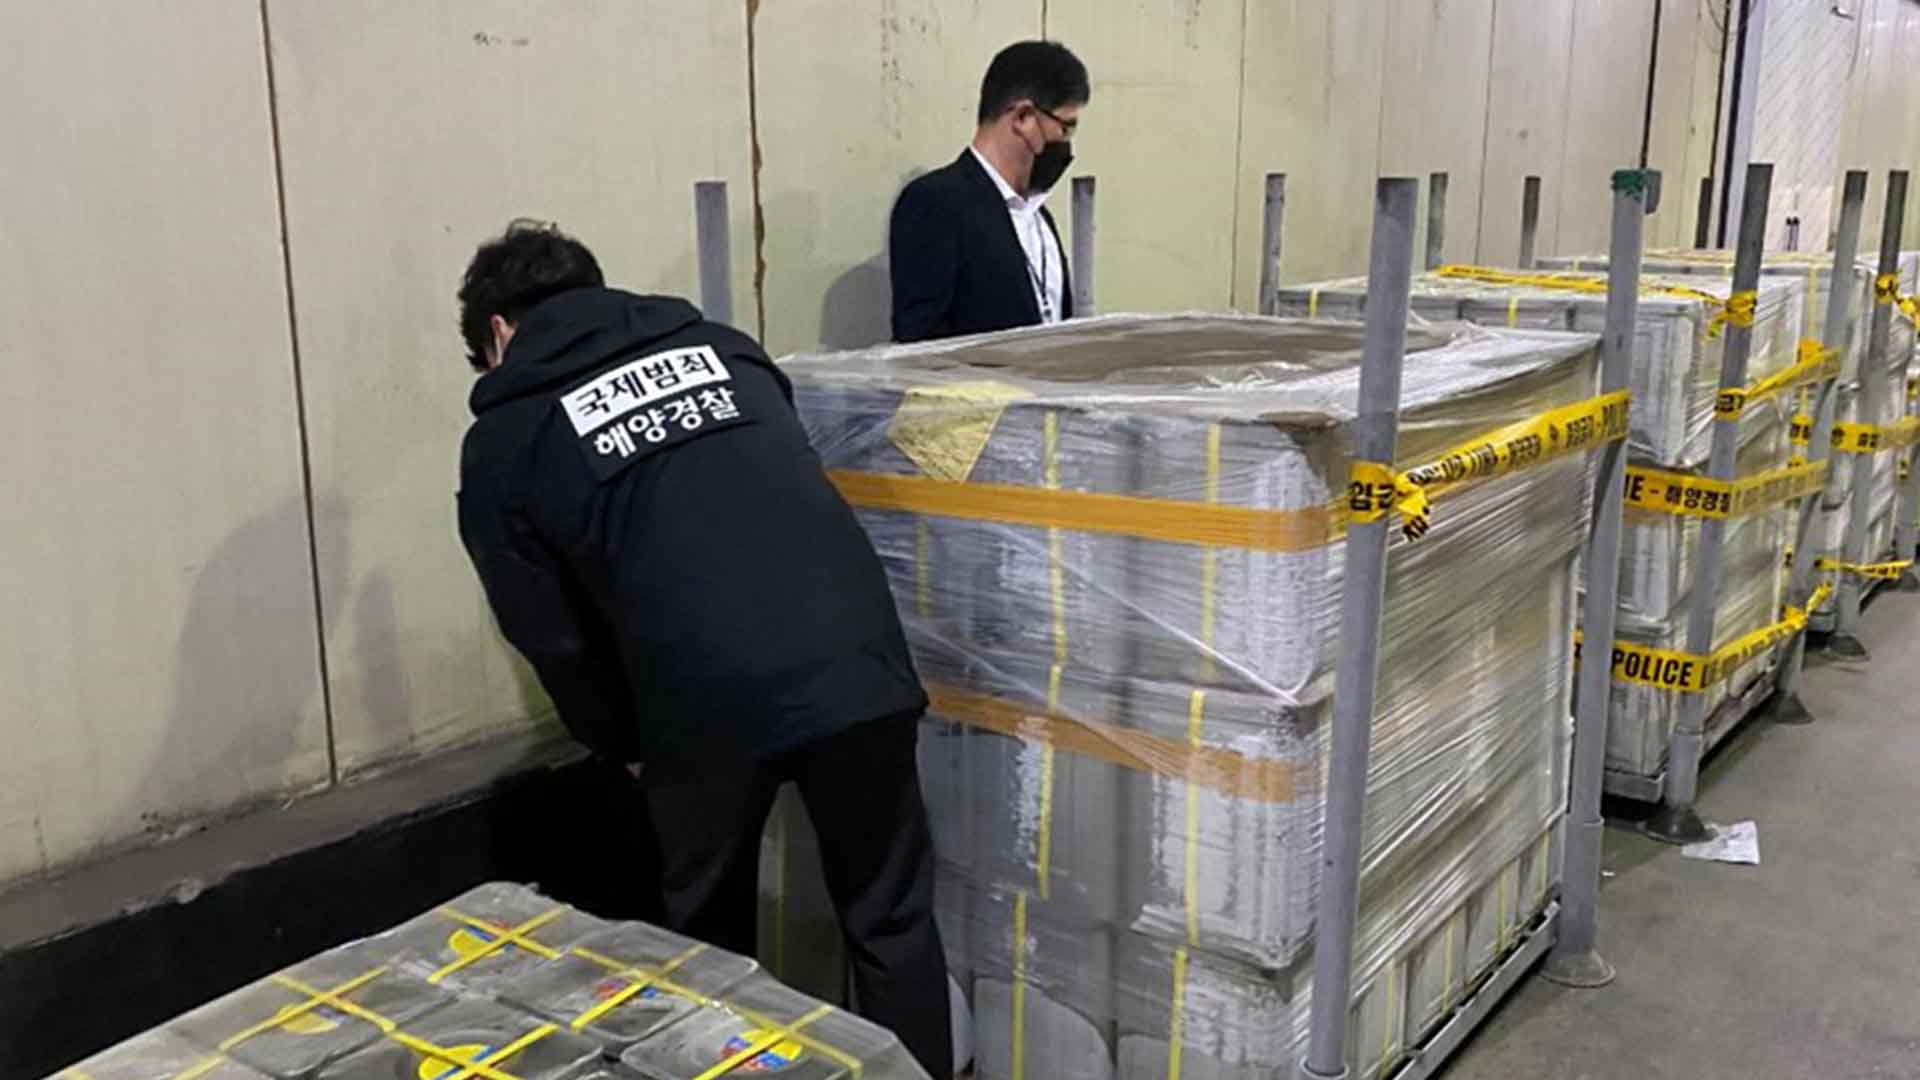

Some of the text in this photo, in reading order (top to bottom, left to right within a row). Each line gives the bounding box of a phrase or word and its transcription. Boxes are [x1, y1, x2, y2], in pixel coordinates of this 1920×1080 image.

[576, 353, 716, 416] 국제범죄
[593, 387, 740, 458] 해양경찰
[1610, 650, 1693, 687] POLICE
